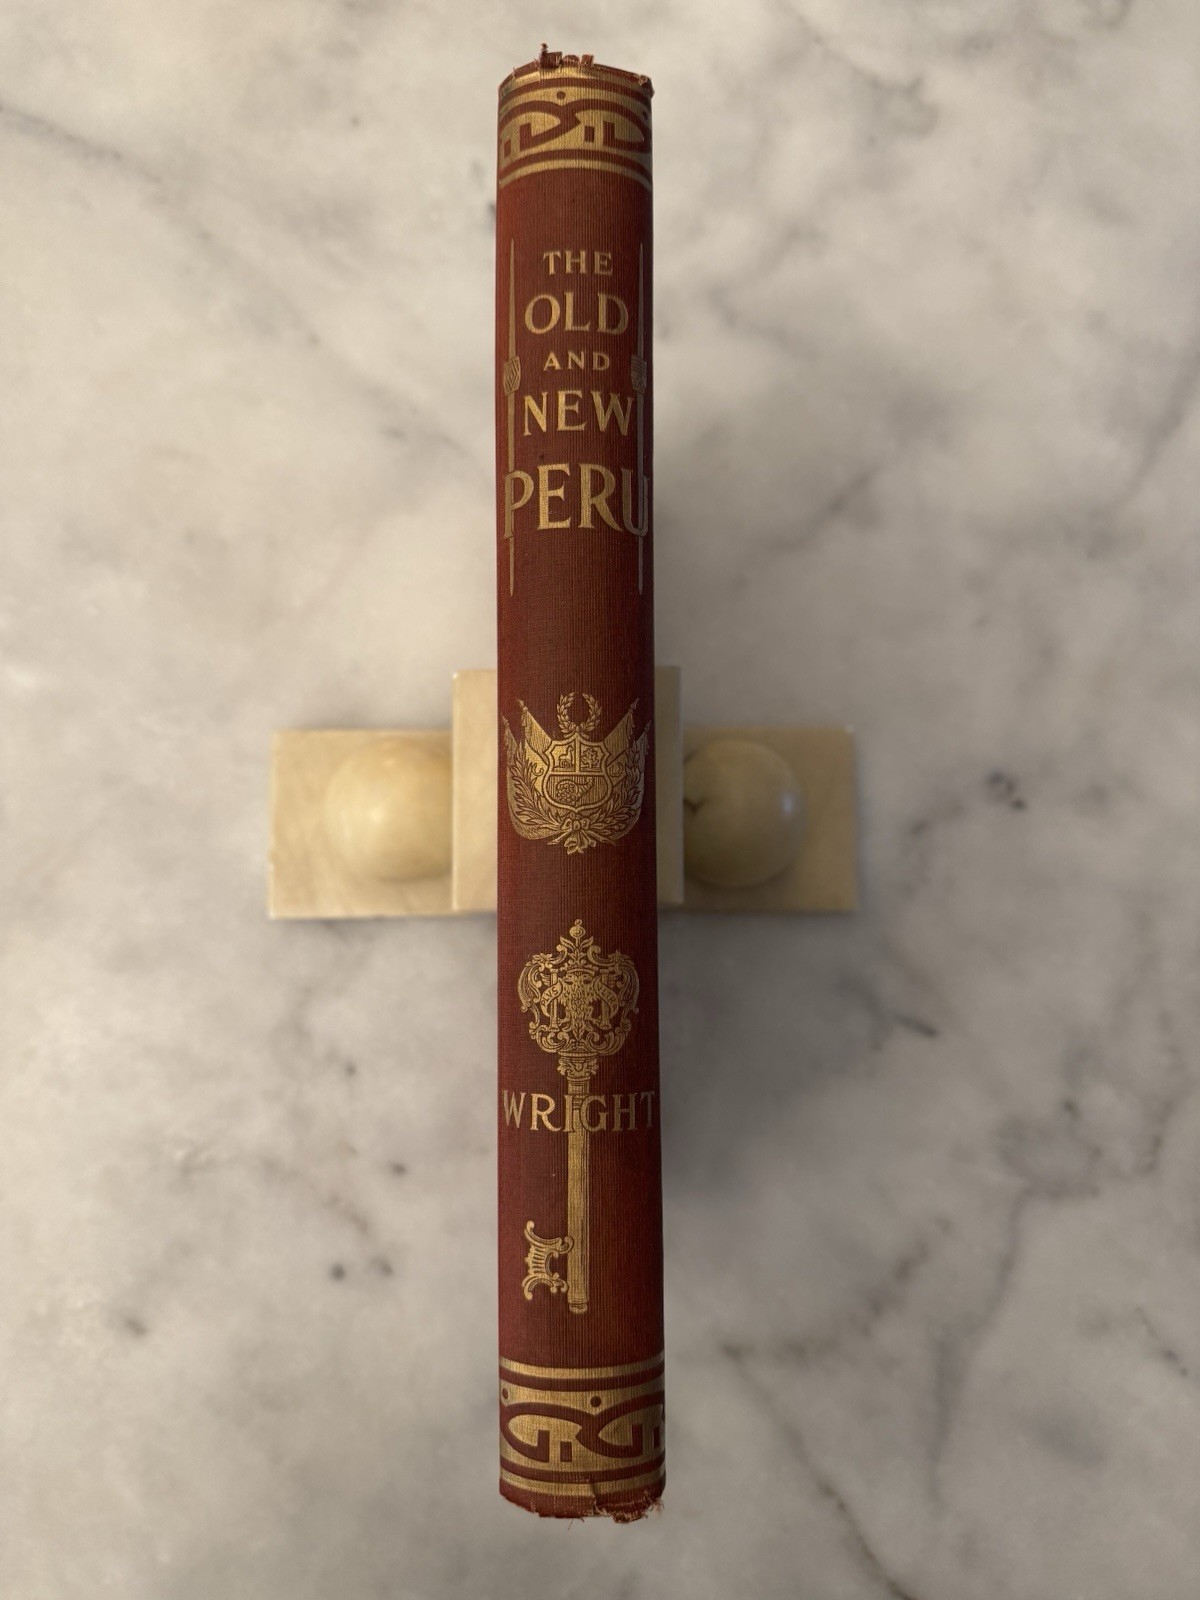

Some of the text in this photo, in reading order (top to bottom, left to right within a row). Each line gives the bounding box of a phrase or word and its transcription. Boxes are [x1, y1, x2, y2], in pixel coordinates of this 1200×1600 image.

[543, 249, 614, 277] THE
[524, 291, 629, 335] OLD
[543, 350, 610, 371] AND
[523, 390, 635, 436] NEW
[504, 463, 650, 539] PERU
[502, 1089, 656, 1132] WRIGHT
